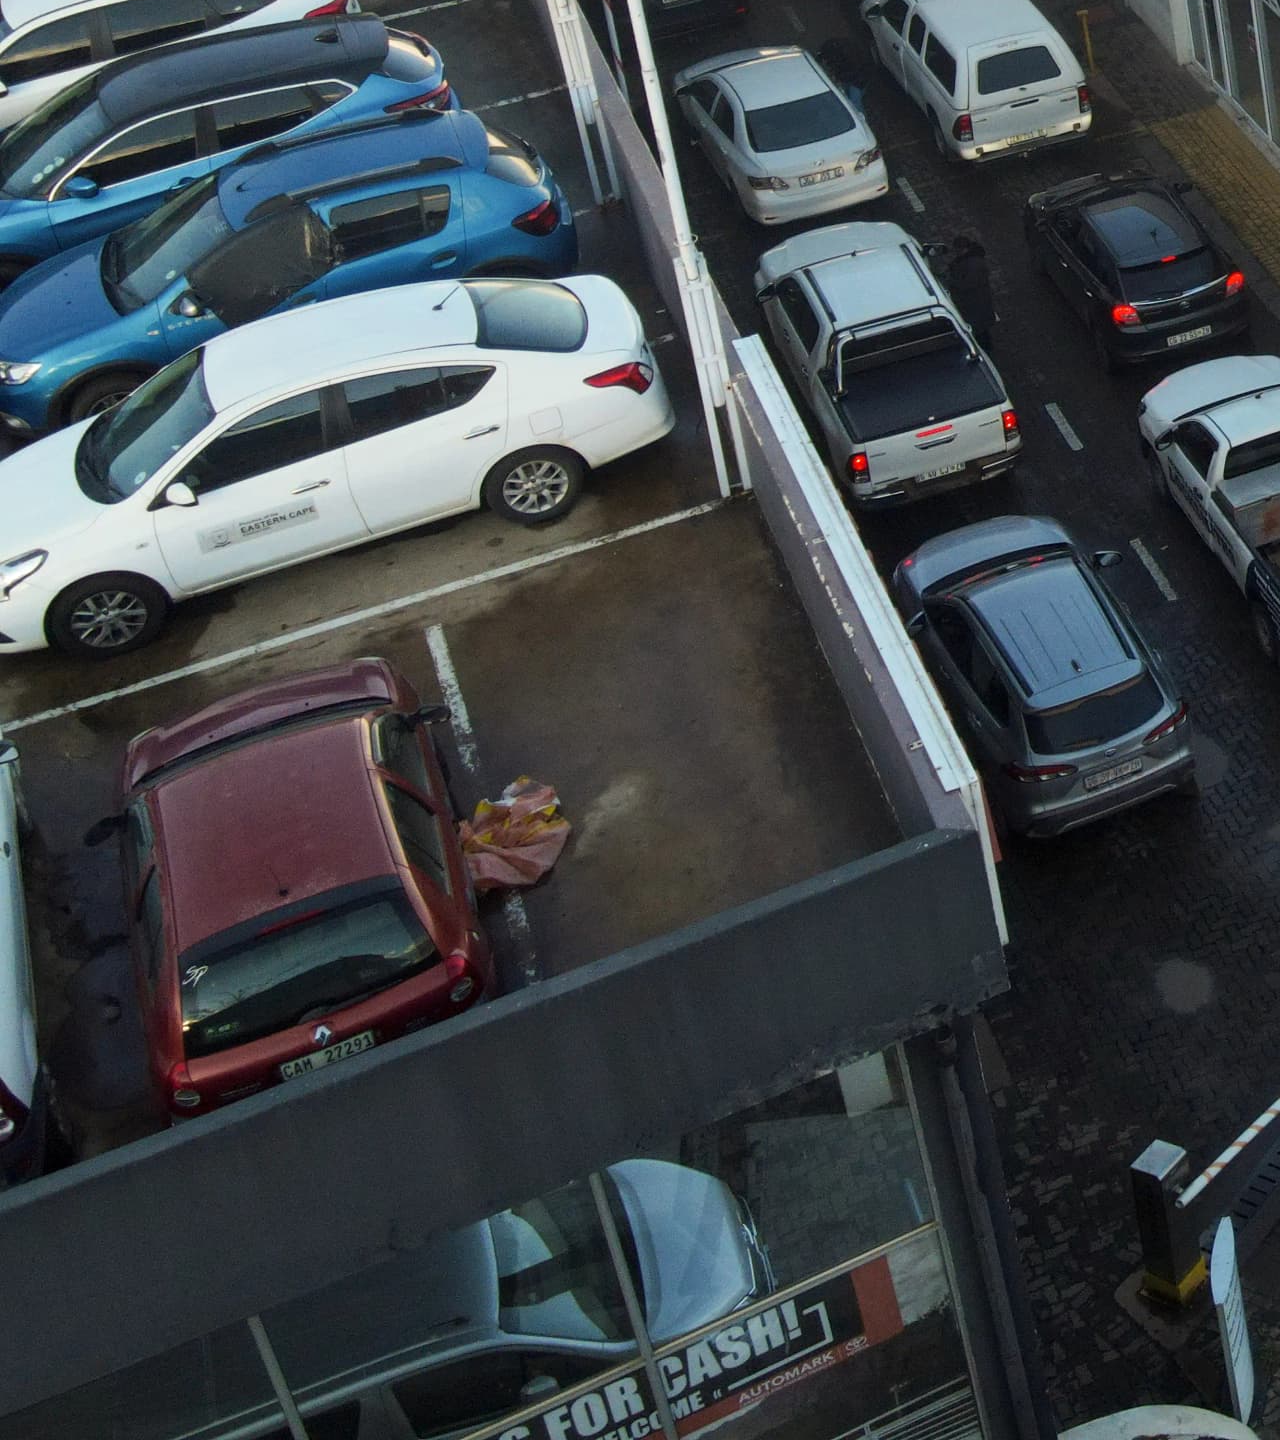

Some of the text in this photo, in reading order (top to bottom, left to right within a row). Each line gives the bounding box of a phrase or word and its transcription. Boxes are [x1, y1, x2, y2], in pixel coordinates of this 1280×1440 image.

[240, 514, 287, 534] EASTERN
[289, 505, 316, 519] CAPE
[325, 1032, 373, 1061] 27291
[543, 1376, 645, 1440] FOR
[658, 1299, 802, 1399] CASH!
[739, 1350, 834, 1404] AUTOMARK
[596, 1391, 705, 1440] ELCOME
